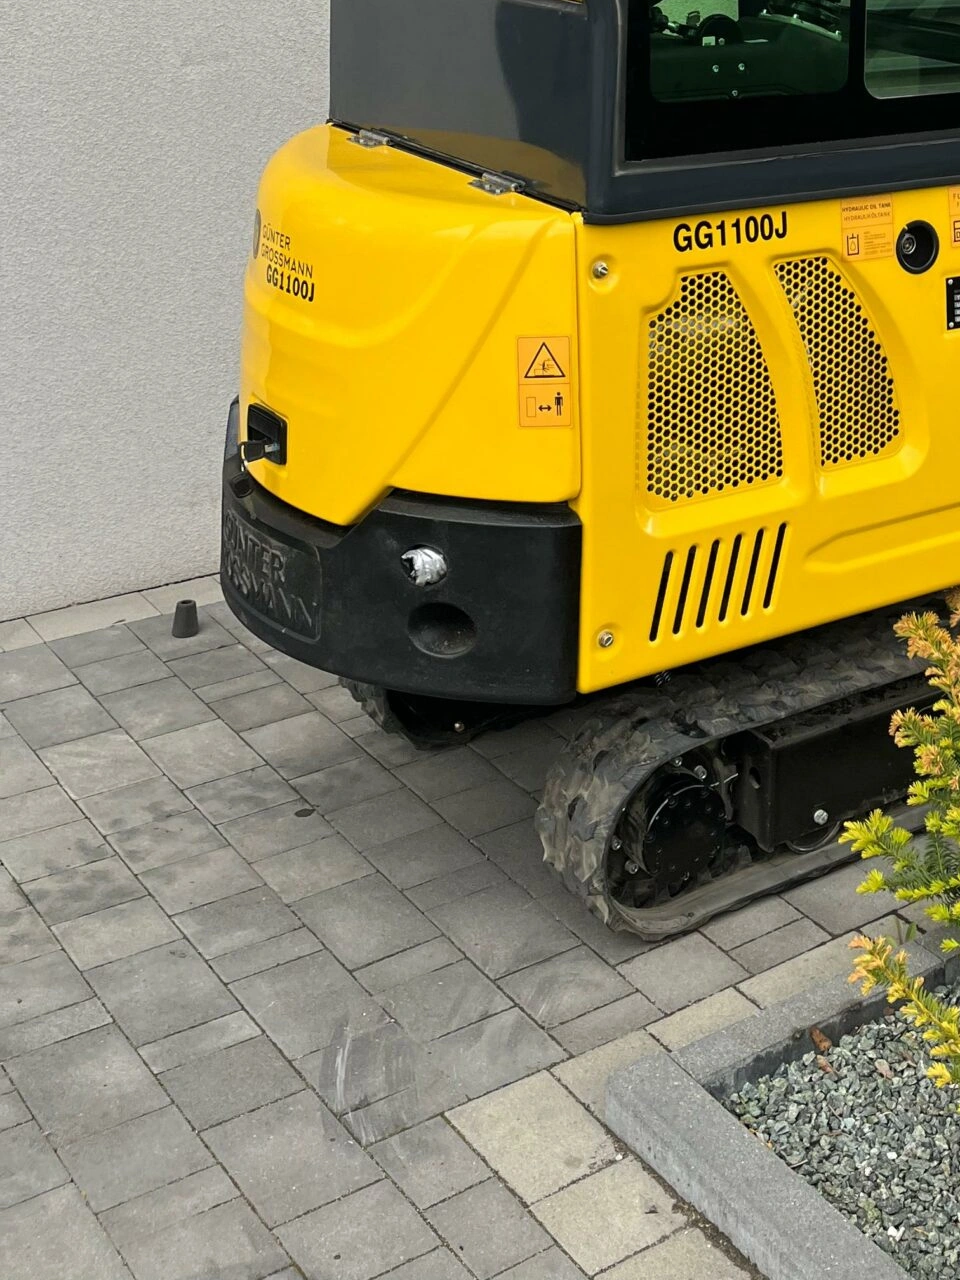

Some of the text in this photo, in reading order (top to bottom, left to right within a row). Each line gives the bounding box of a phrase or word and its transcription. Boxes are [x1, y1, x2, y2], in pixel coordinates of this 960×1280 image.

[673, 211, 788, 252] GG1100J
[261, 243, 313, 279] GROSSMANN
[266, 264, 315, 302] GG1100J
